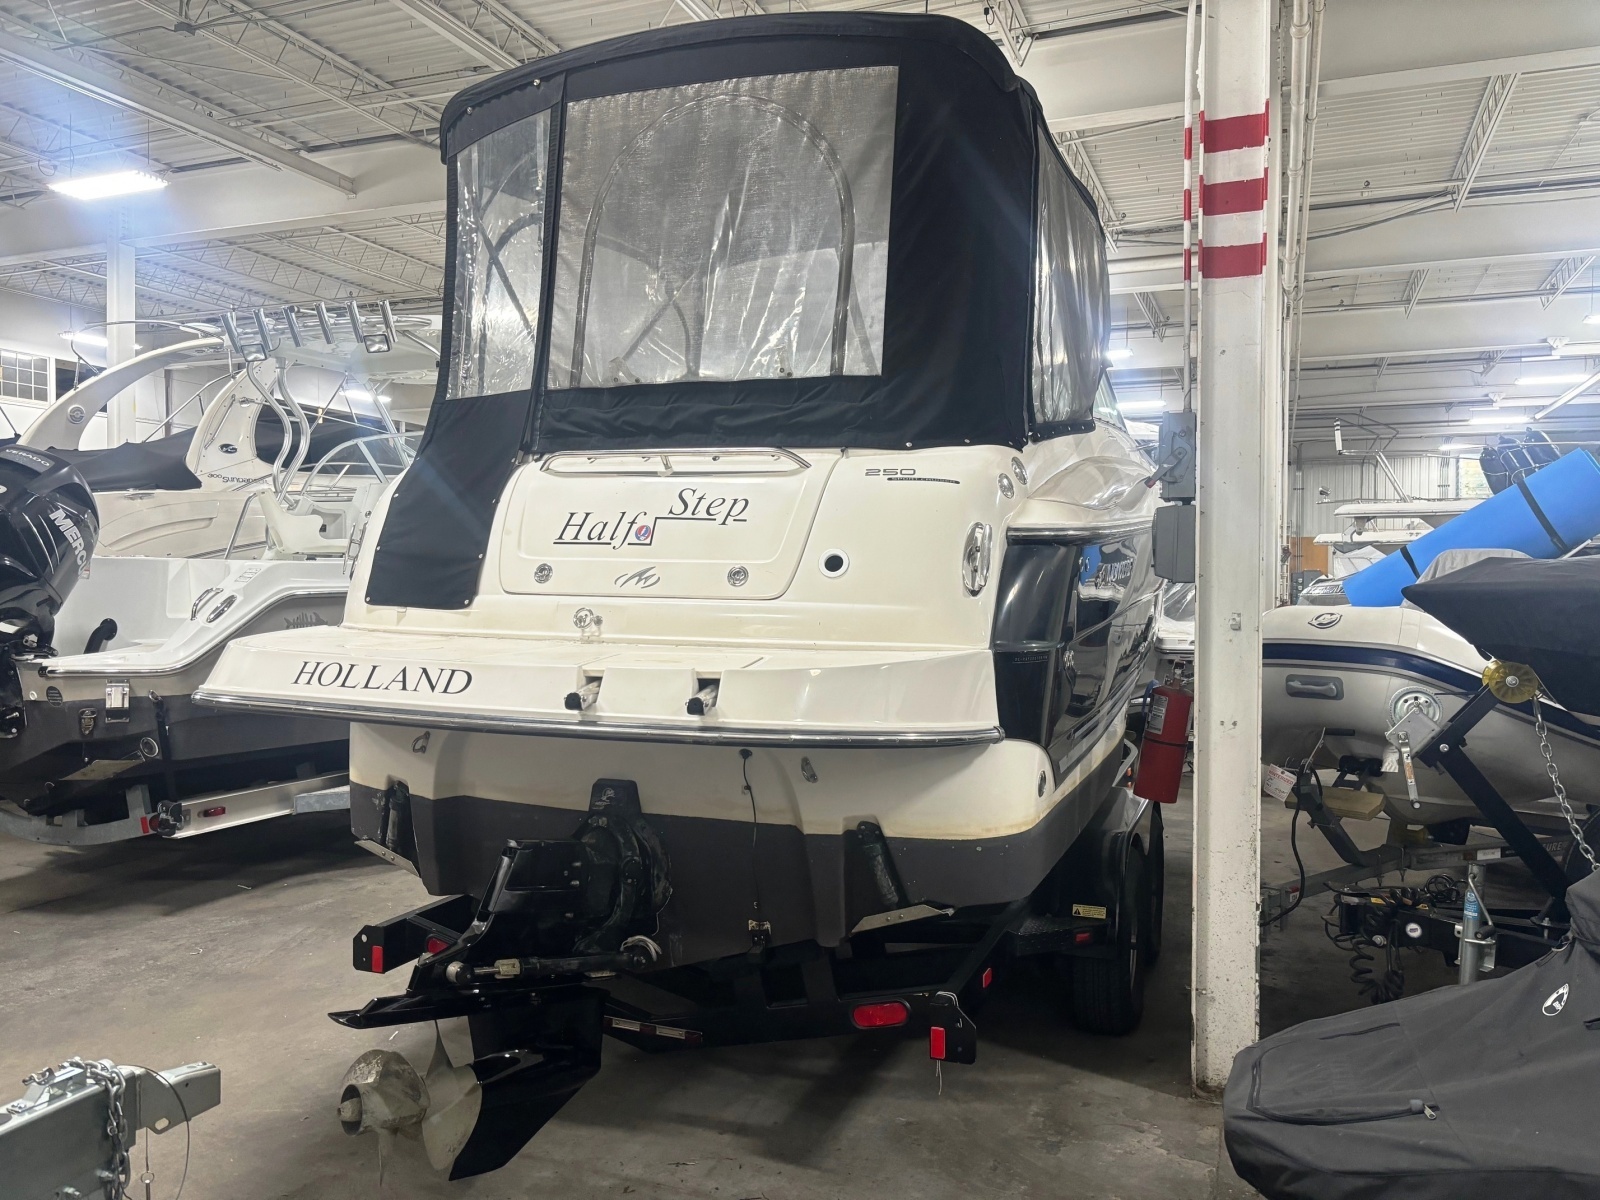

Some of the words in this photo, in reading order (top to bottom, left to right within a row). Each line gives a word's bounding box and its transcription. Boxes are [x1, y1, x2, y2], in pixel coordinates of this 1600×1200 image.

[864, 468, 917, 477] 250
[555, 511, 647, 550] Half
[668, 488, 749, 525] Step
[290, 660, 473, 695] HOLLAND
